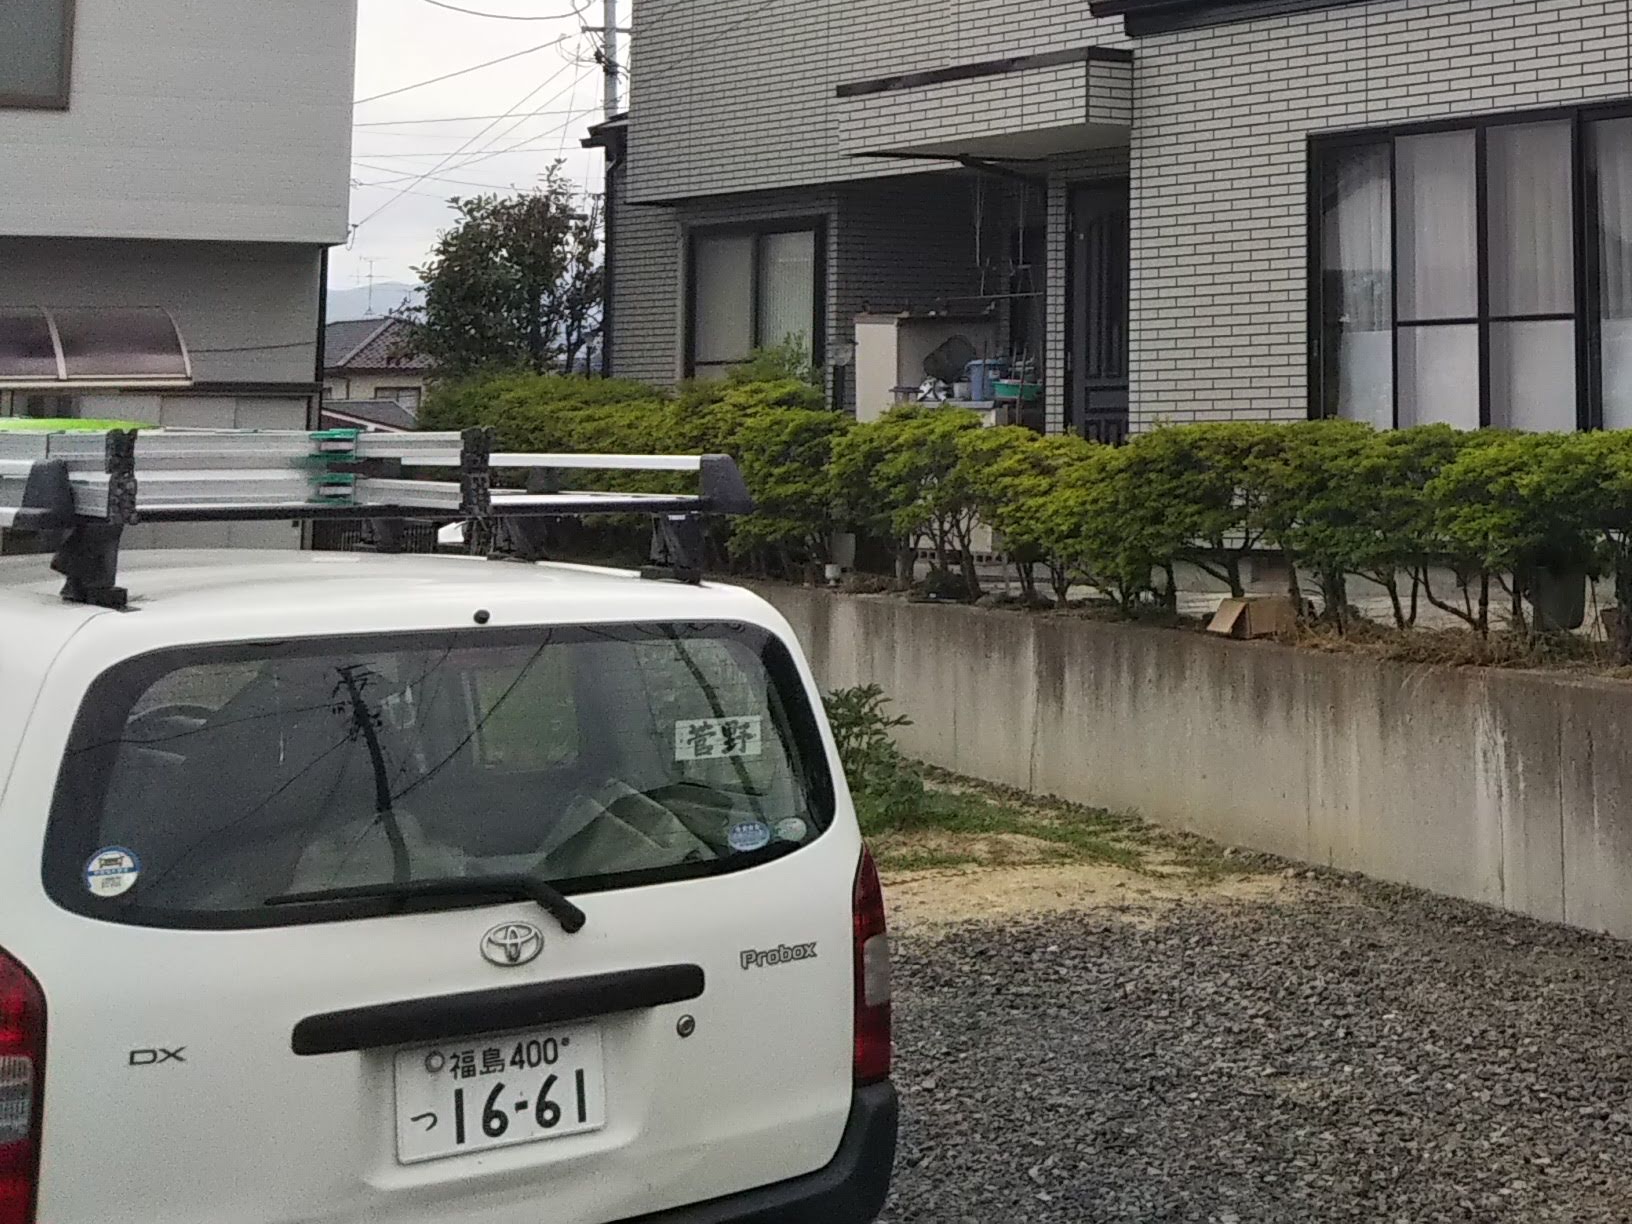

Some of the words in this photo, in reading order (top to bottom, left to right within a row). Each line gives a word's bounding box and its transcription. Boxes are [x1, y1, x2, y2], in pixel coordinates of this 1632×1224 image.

[687, 720, 755, 756] 菅野
[740, 941, 818, 970] Probox
[129, 1045, 187, 1066] DX
[454, 1068, 587, 1145] 16-61
